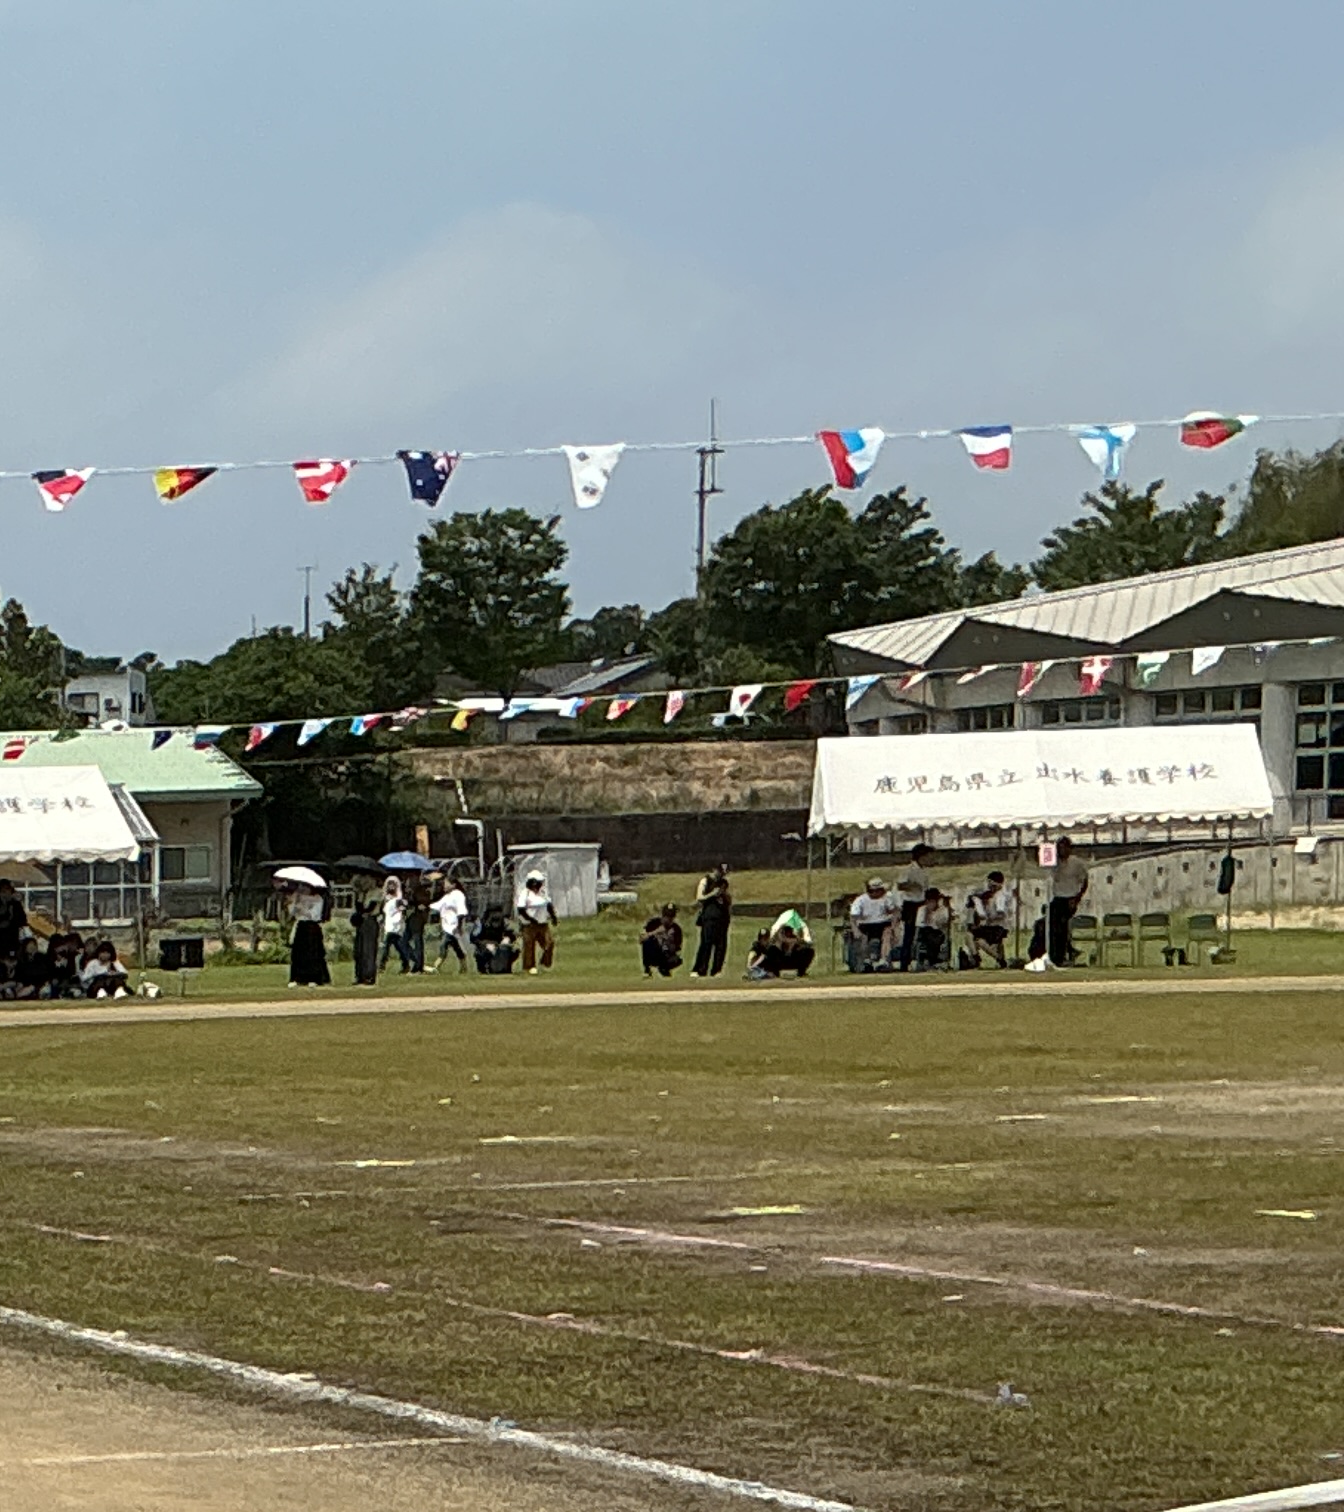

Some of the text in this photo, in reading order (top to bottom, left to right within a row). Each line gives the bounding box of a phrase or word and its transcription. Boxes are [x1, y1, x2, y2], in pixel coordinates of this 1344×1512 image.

[873, 762, 1218, 795] 鹿児島県立出水養護学校
